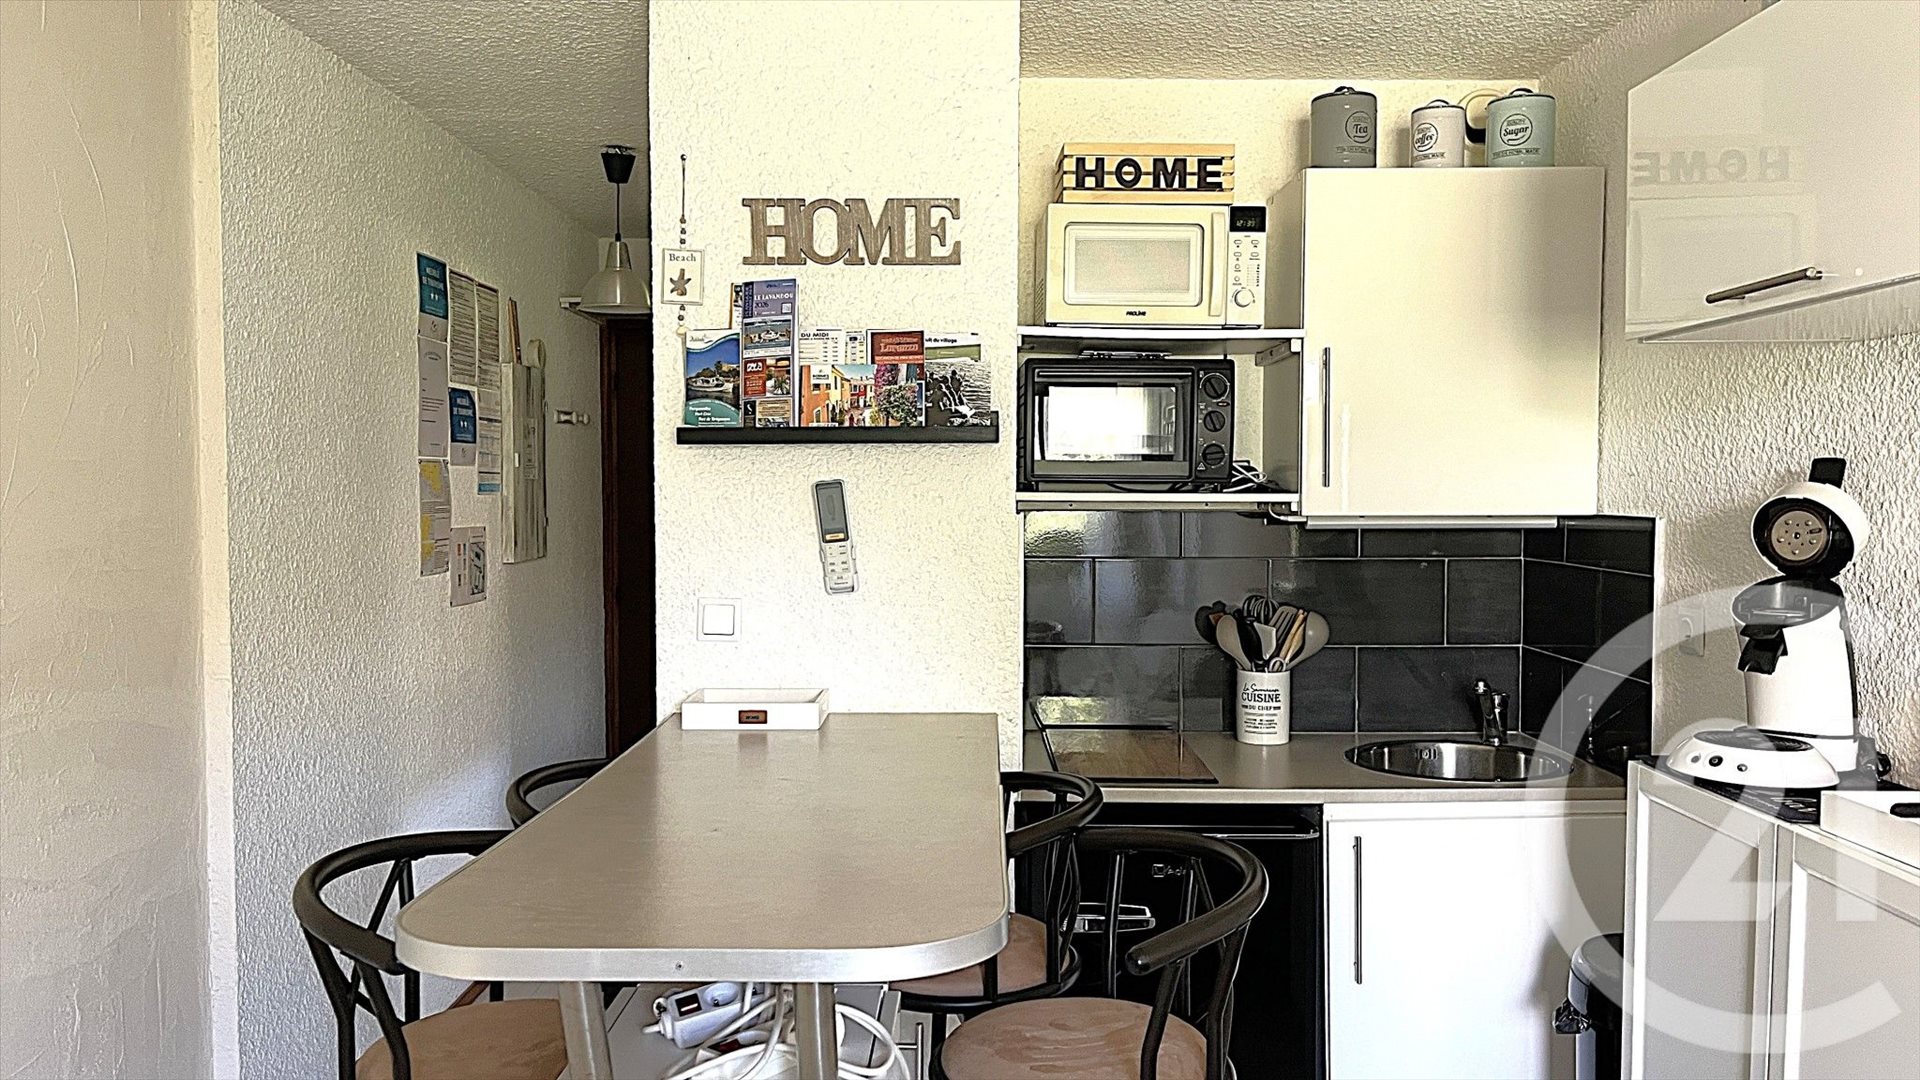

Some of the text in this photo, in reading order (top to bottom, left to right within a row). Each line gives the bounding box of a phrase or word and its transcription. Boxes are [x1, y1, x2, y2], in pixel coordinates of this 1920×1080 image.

[1353, 123, 1368, 134] Tea
[1503, 126, 1530, 137] Sugar
[1075, 157, 1223, 189] HOME
[742, 198, 961, 265] HOME
[669, 253, 697, 262] Beach
[1241, 692, 1281, 703] CUISINE
